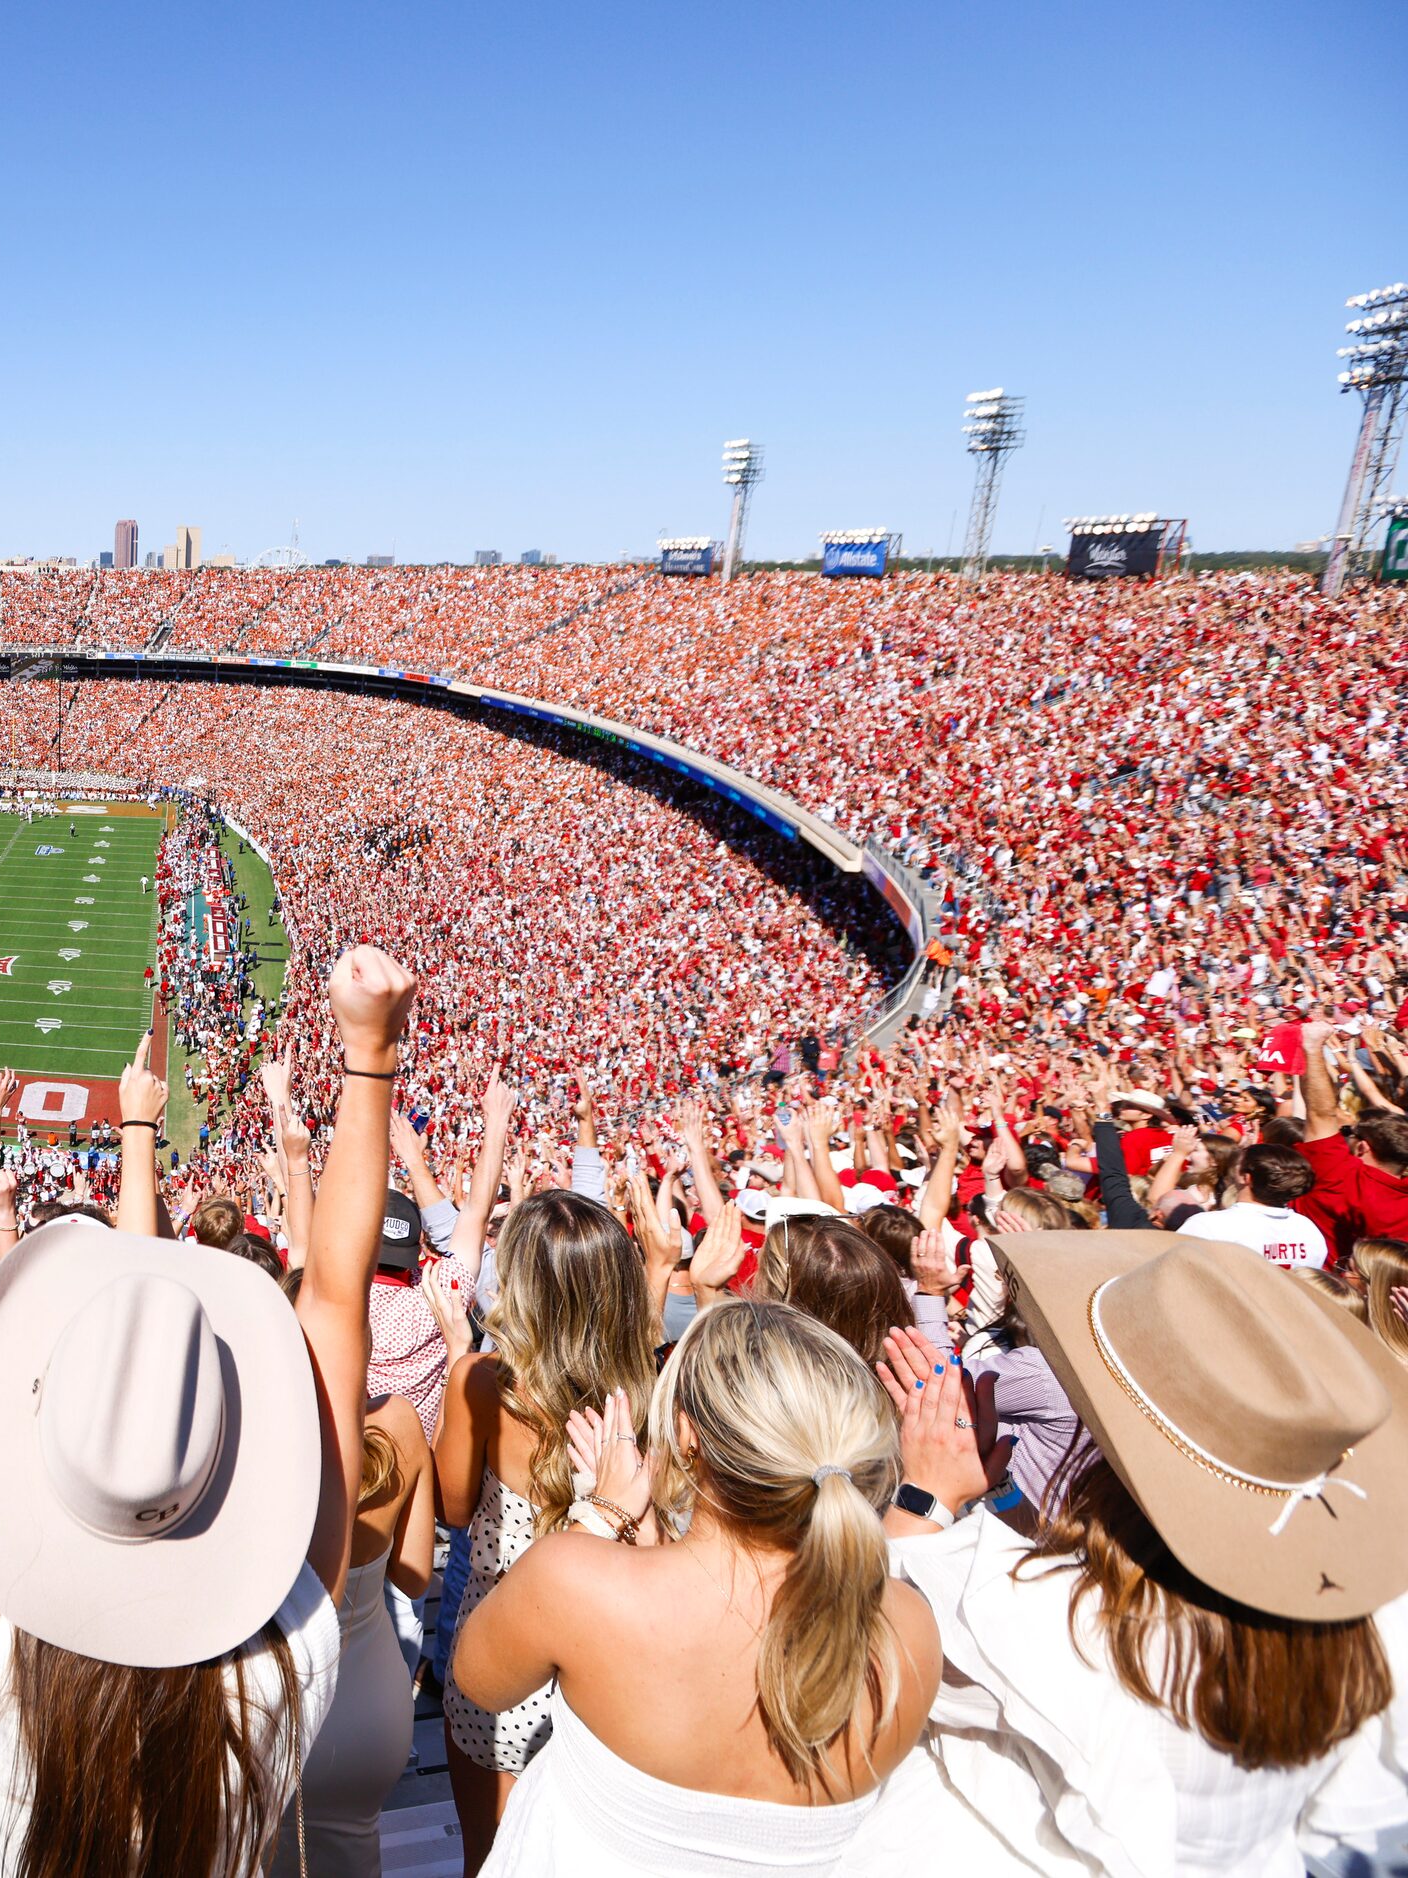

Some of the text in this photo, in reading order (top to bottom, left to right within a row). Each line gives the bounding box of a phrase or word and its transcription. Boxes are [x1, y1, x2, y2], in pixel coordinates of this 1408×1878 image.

[839, 551, 878, 567] Allstate
[1263, 1243, 1307, 1260] HURTS
[134, 1502, 180, 1524] CB
